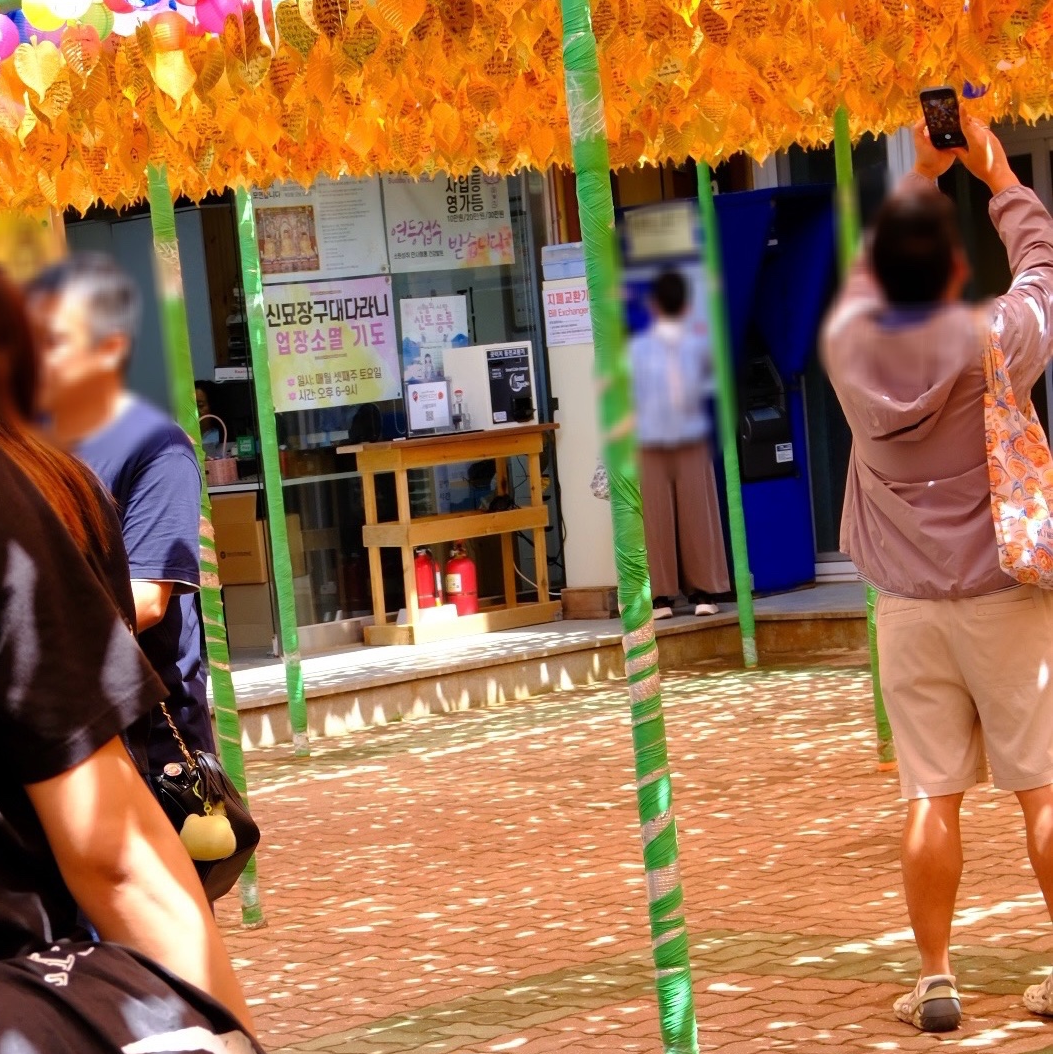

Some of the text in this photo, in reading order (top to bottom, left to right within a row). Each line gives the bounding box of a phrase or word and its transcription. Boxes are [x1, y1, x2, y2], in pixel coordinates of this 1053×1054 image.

[446, 174, 481, 194] 사업등
[446, 195, 484, 213] 영가등
[391, 220, 442, 246] 연등접수
[266, 294, 389, 328] 신묘장구대다라니
[276, 323, 385, 355] 업장소멸 기도
[359, 367, 382, 380] 토요일
[299, 384, 358, 401] 시간: 오후 6-9시
